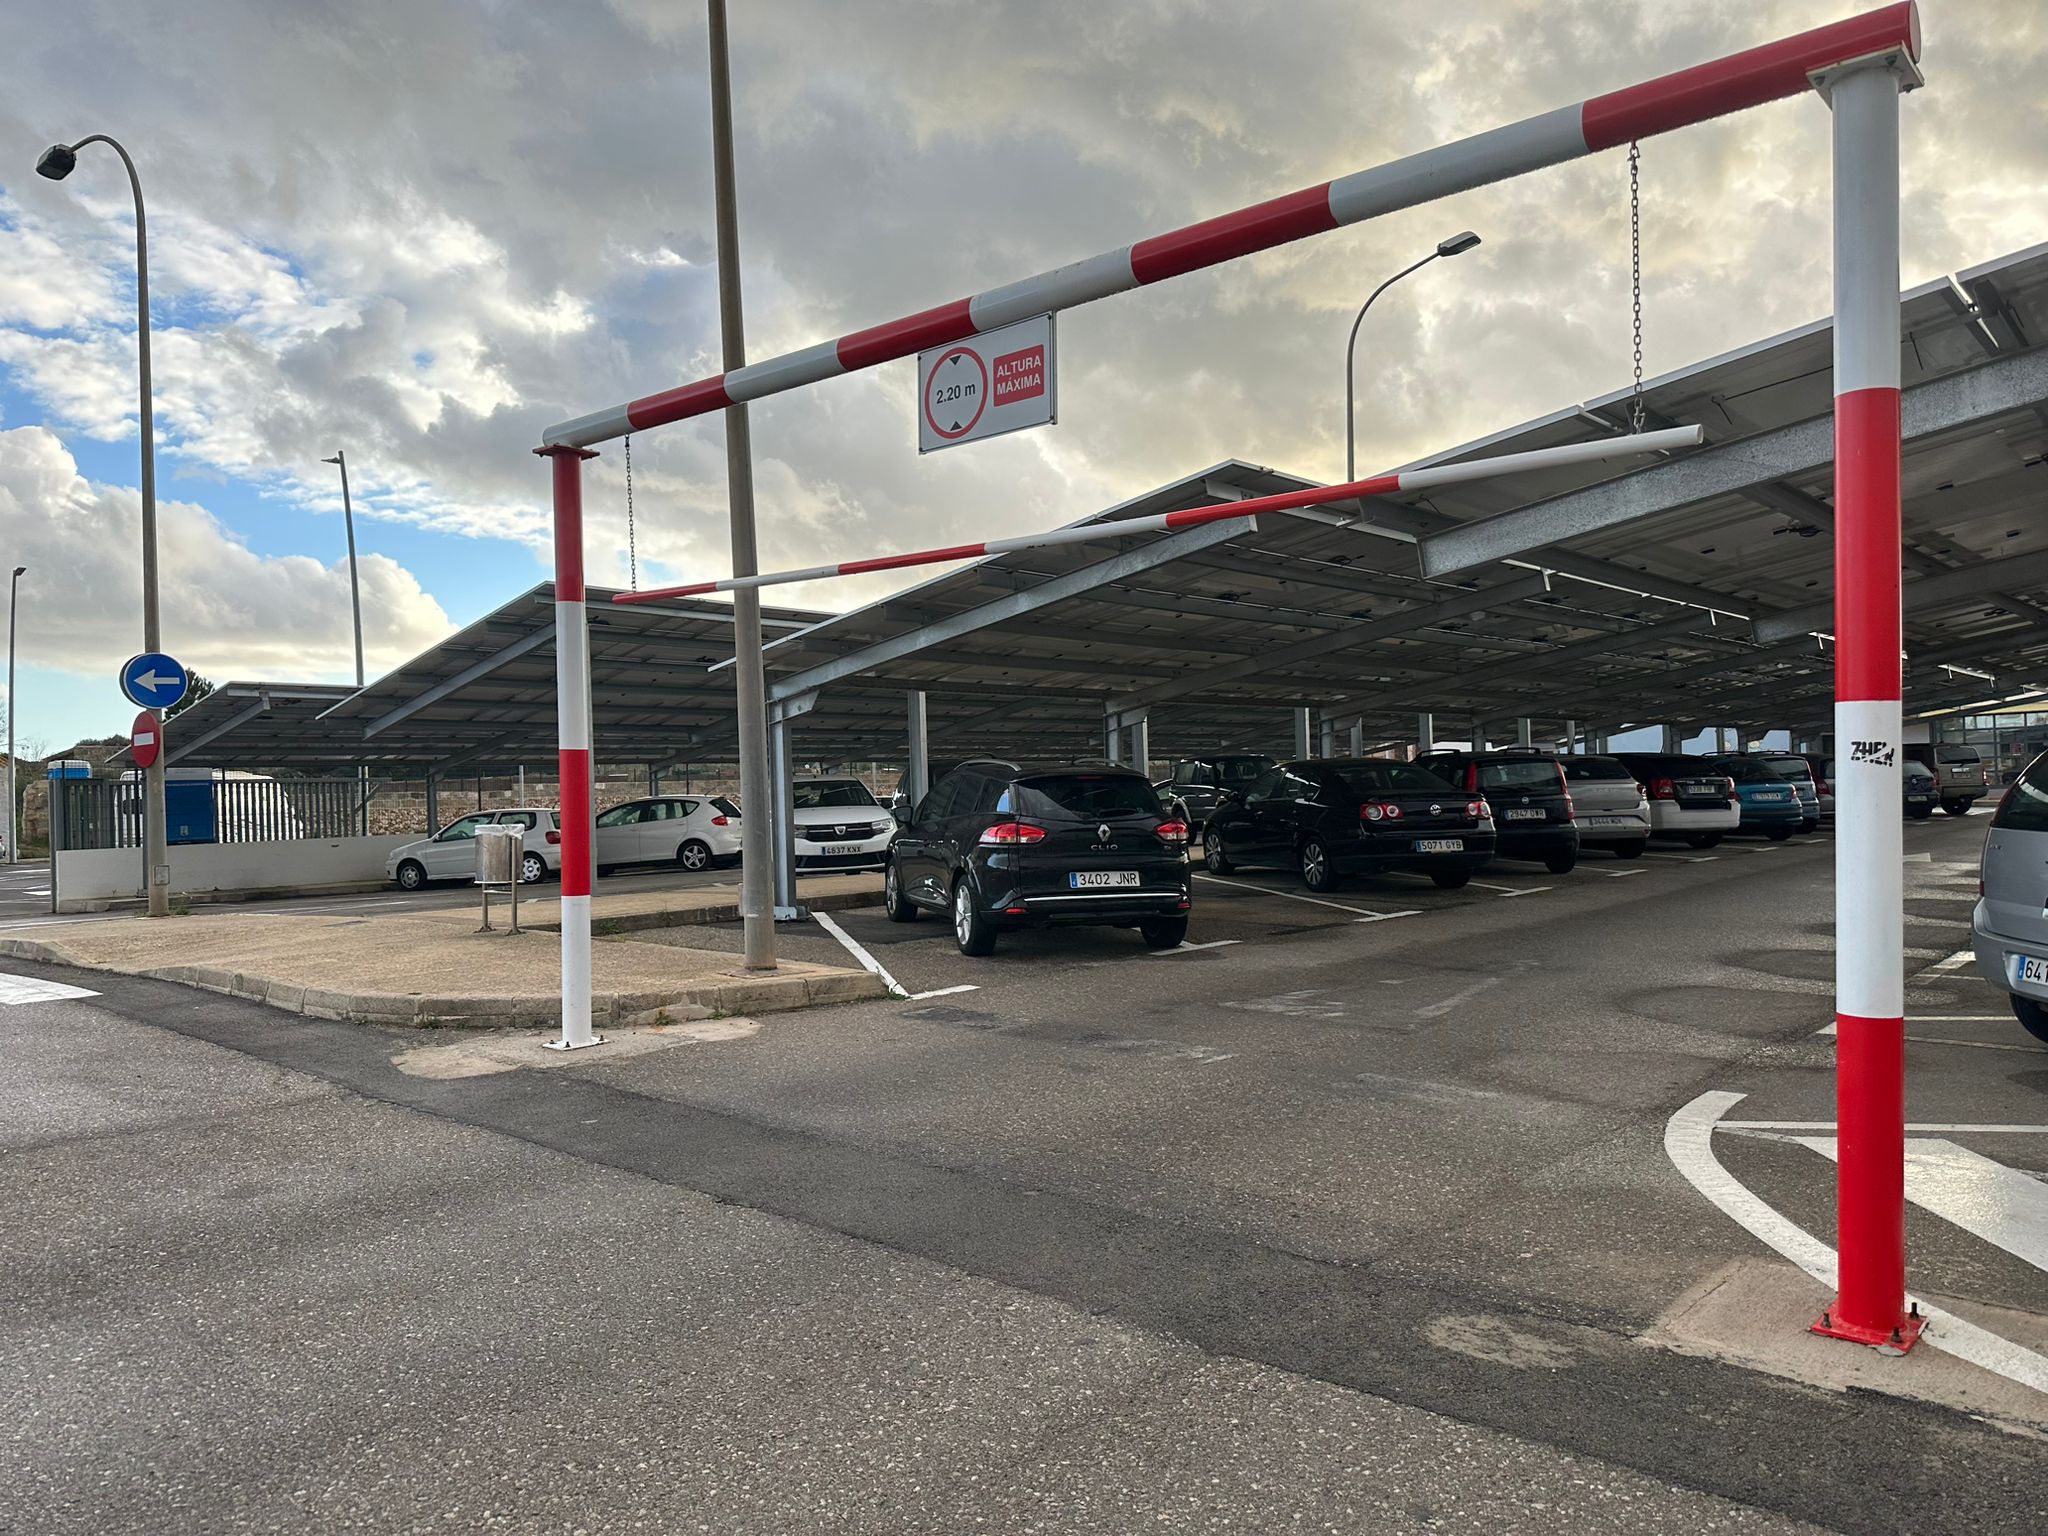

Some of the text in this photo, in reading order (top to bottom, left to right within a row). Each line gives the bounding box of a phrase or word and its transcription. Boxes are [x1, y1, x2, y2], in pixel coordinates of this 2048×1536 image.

[997, 355, 1041, 378] ALTURA
[997, 373, 1041, 396] MÁXIMA
[936, 384, 976, 404] 2.20 m
[827, 846, 845, 854] 4637
[1421, 840, 1462, 850] 5071 GYB
[1079, 872, 1137, 886] 3402 JNR
